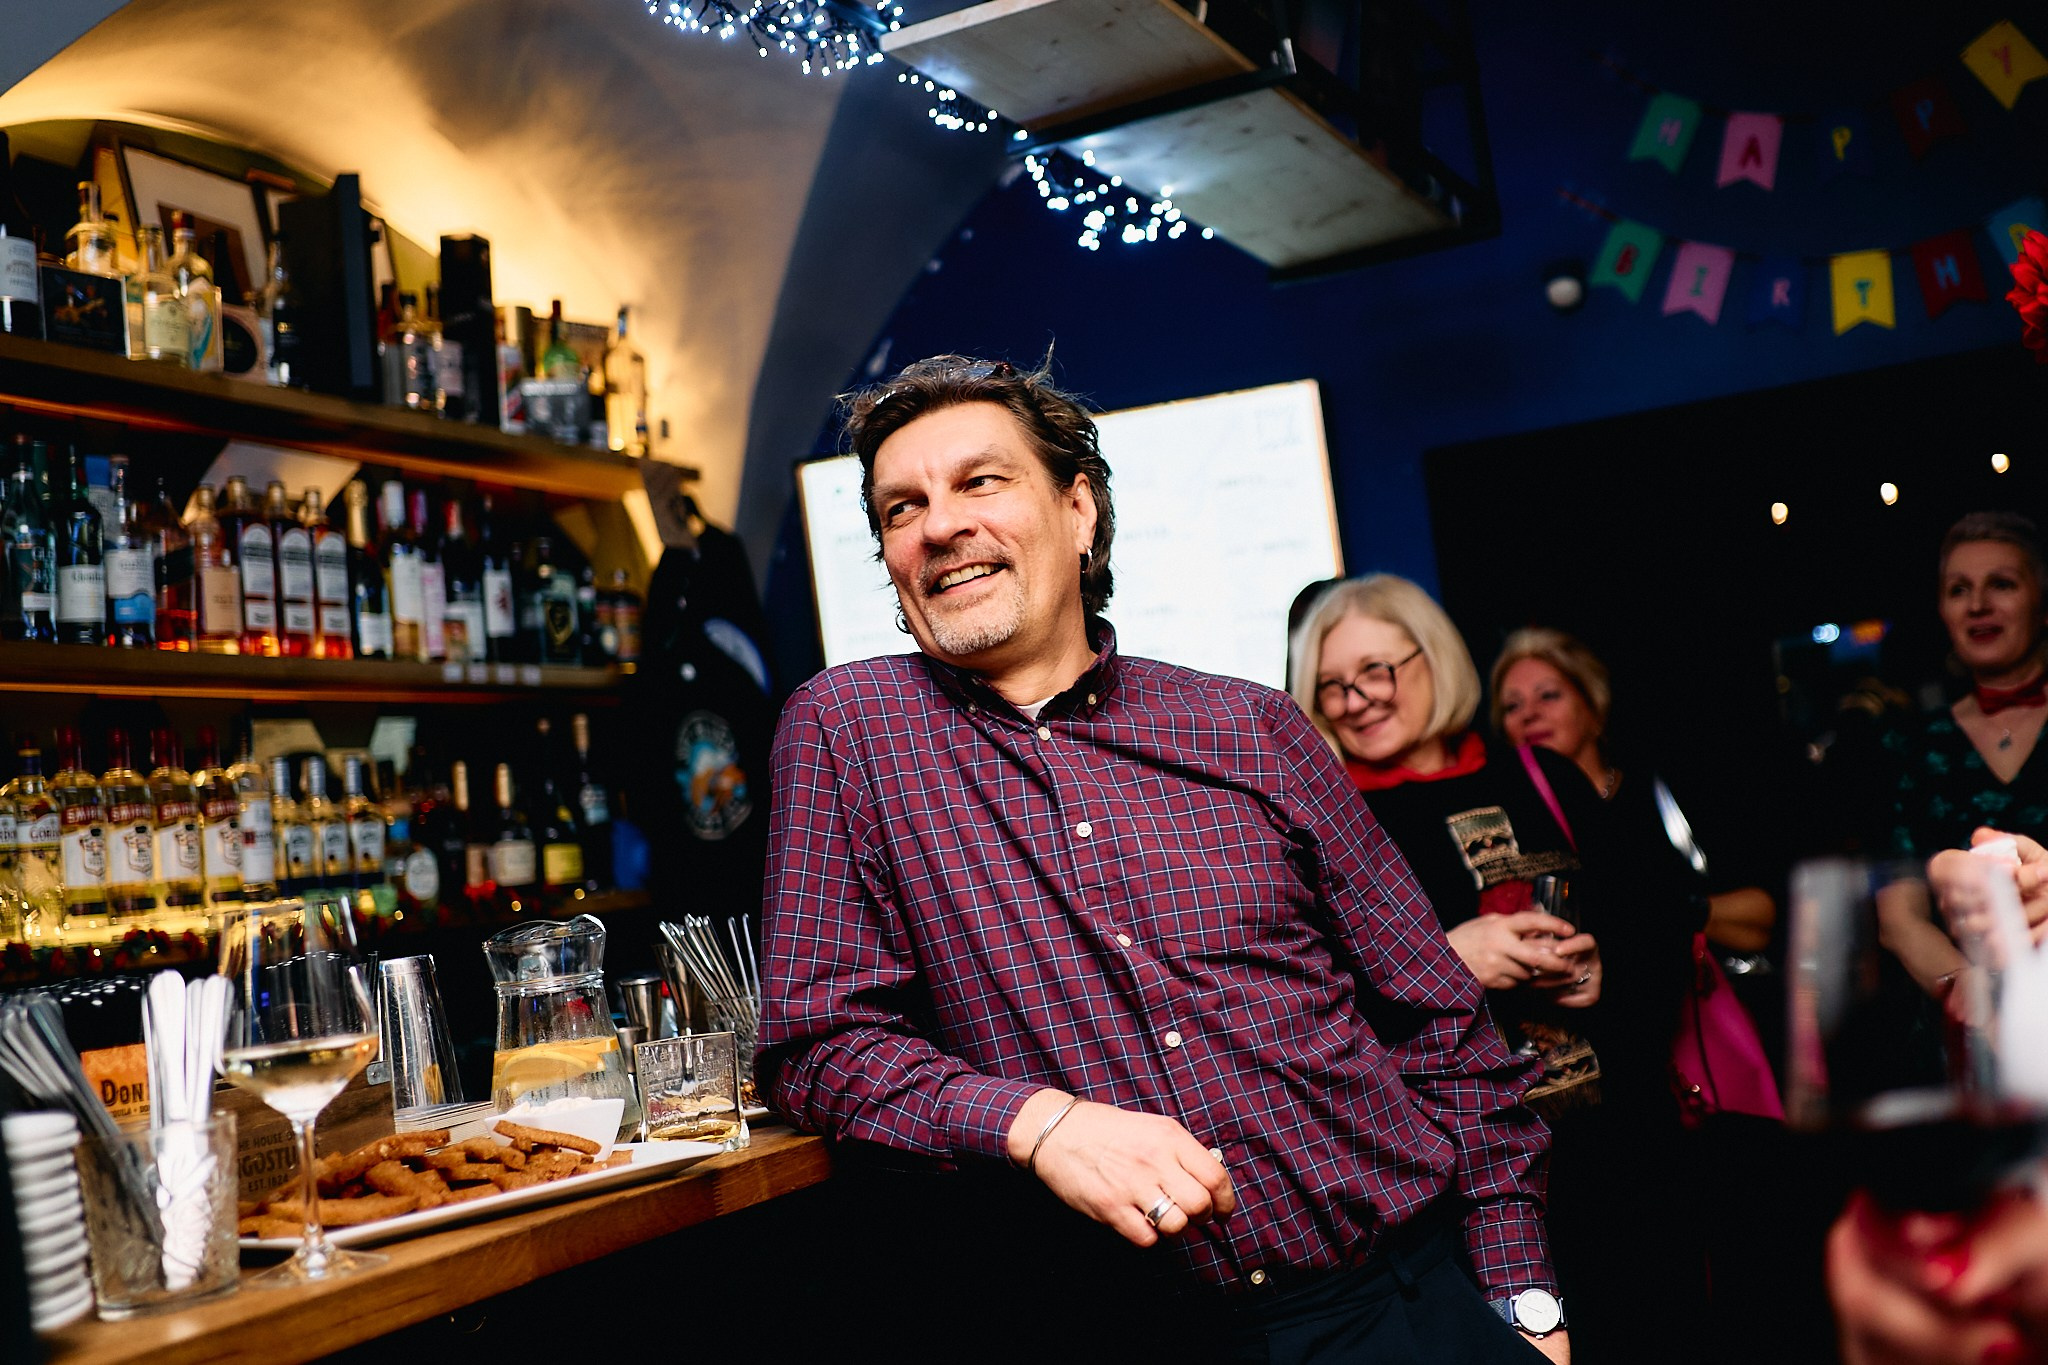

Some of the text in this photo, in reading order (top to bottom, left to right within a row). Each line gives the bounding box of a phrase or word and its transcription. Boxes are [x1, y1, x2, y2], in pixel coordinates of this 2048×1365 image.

[1656, 45, 2014, 168] HAPPY
[239, 1138, 250, 1152] HE
[253, 1133, 282, 1148] HOUSE
